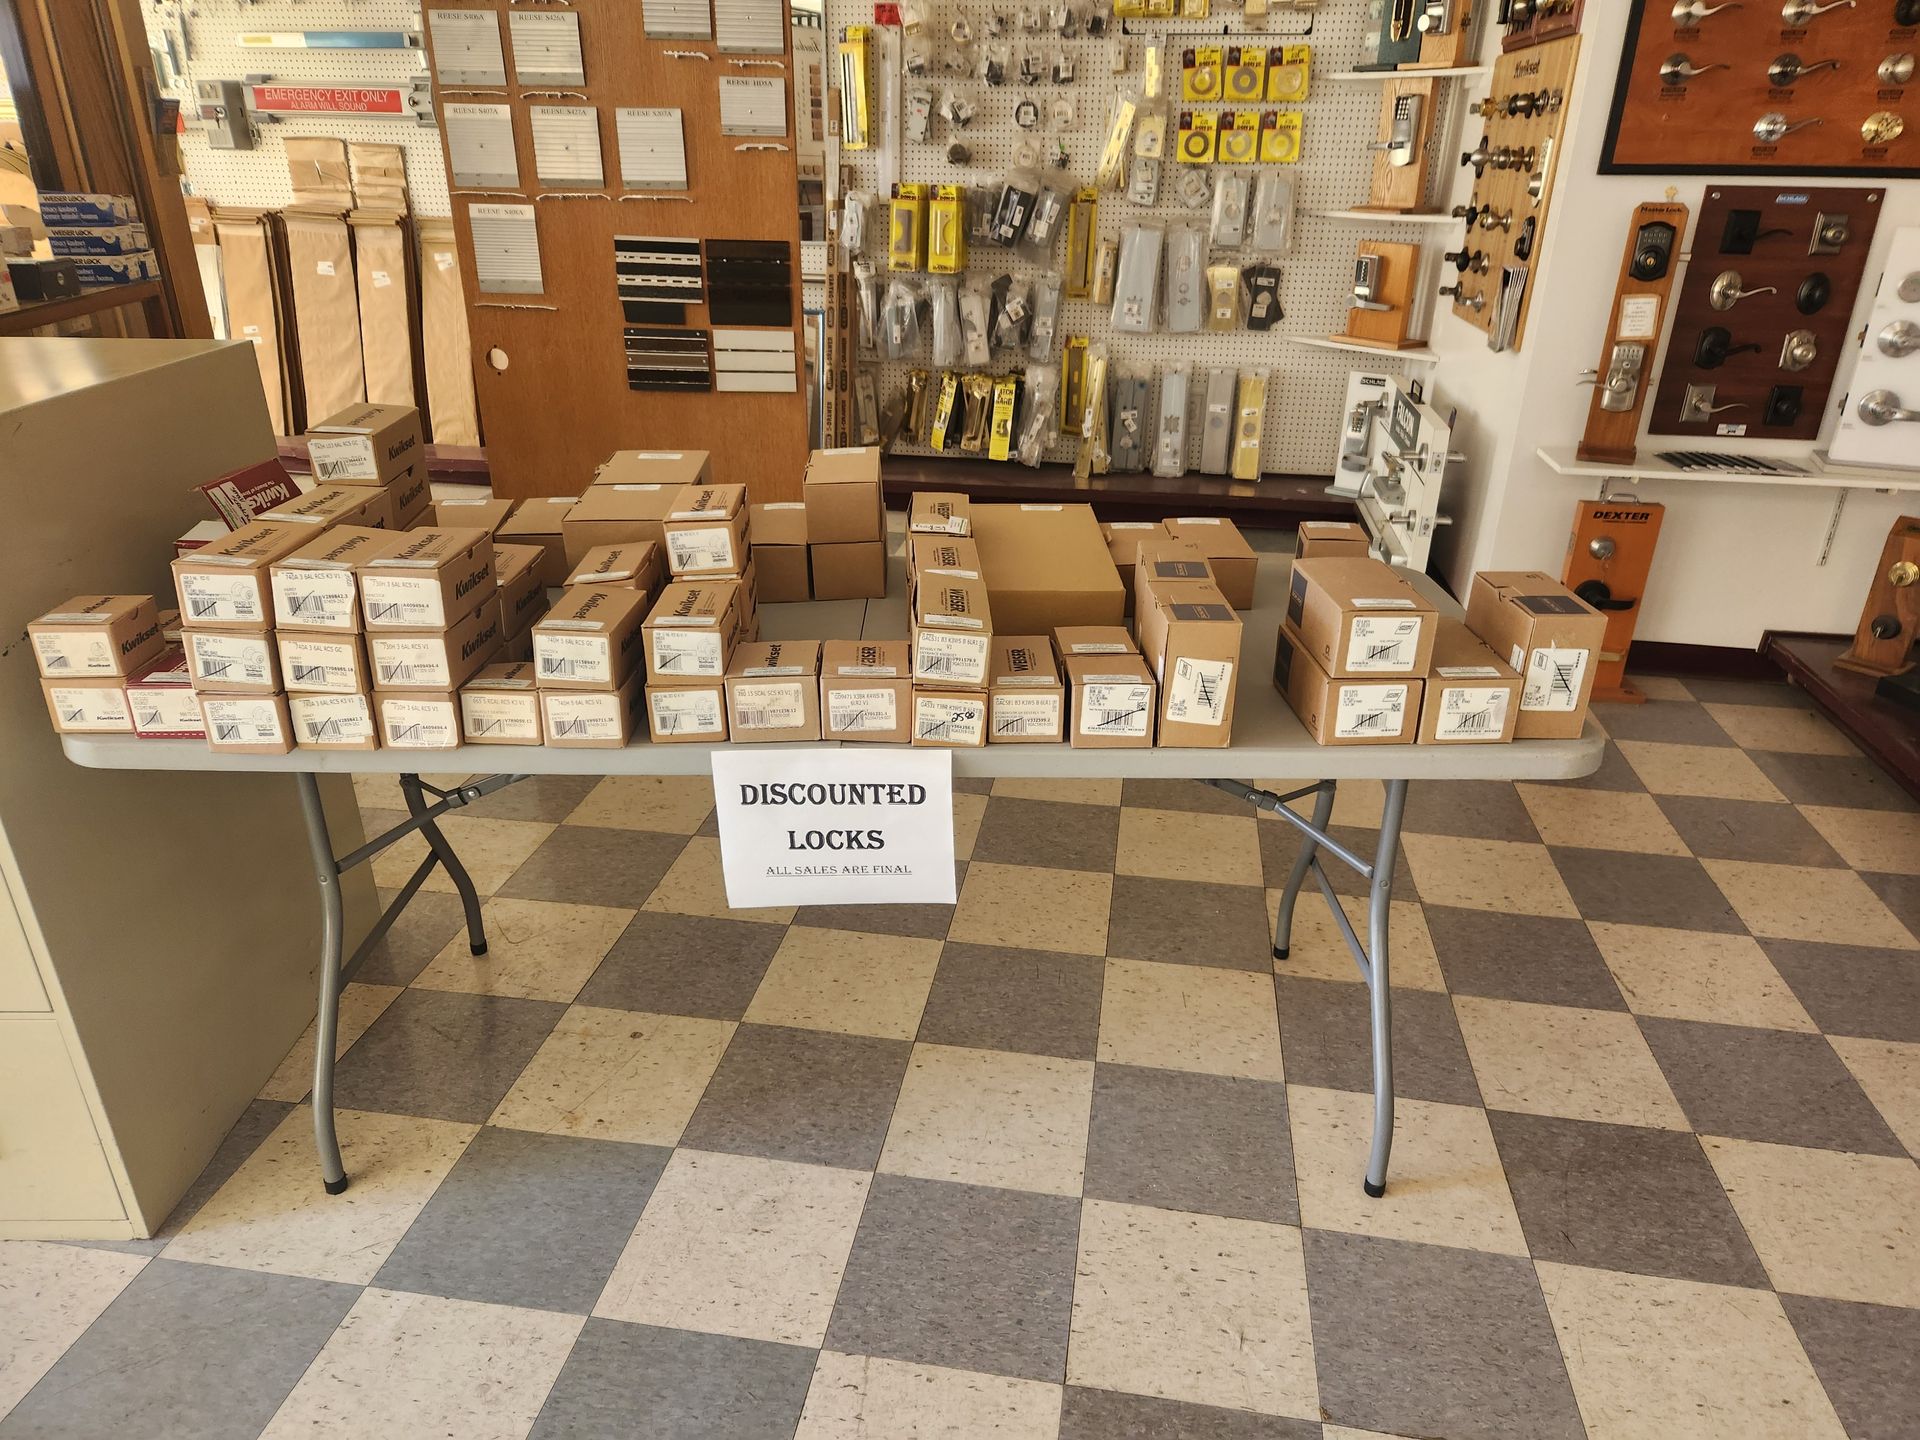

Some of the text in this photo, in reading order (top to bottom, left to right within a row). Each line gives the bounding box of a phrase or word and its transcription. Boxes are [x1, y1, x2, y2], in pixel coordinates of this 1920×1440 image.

[437, 12, 462, 20] REESE
[264, 87, 388, 102] EMERGENCY EXIT ONLY
[291, 101, 368, 111] ALARM WILL SOUND
[477, 207, 499, 215] REESE
[387, 434, 416, 462] Kwikset
[246, 482, 290, 511] Kwiks
[291, 490, 345, 516] Kwikset
[399, 480, 425, 510] Kwikset
[1593, 511, 1650, 521] DEXTER
[218, 527, 279, 557] Kwikset
[393, 533, 442, 560] Kwikset
[940, 546, 957, 567] WEISER
[455, 562, 489, 600] Kwikset
[573, 592, 608, 620] Kwikset
[673, 589, 702, 617] Kwikset
[949, 588, 966, 613] WEISER
[121, 623, 159, 656] Kwikset
[462, 622, 497, 661] Kwikset
[767, 643, 782, 667] wikset
[1010, 648, 1029, 673] WEISER
[740, 782, 927, 806] DISCOUNTED
[787, 829, 885, 850] LOCKS
[766, 864, 912, 875] ALL SALES ARE FINAL
